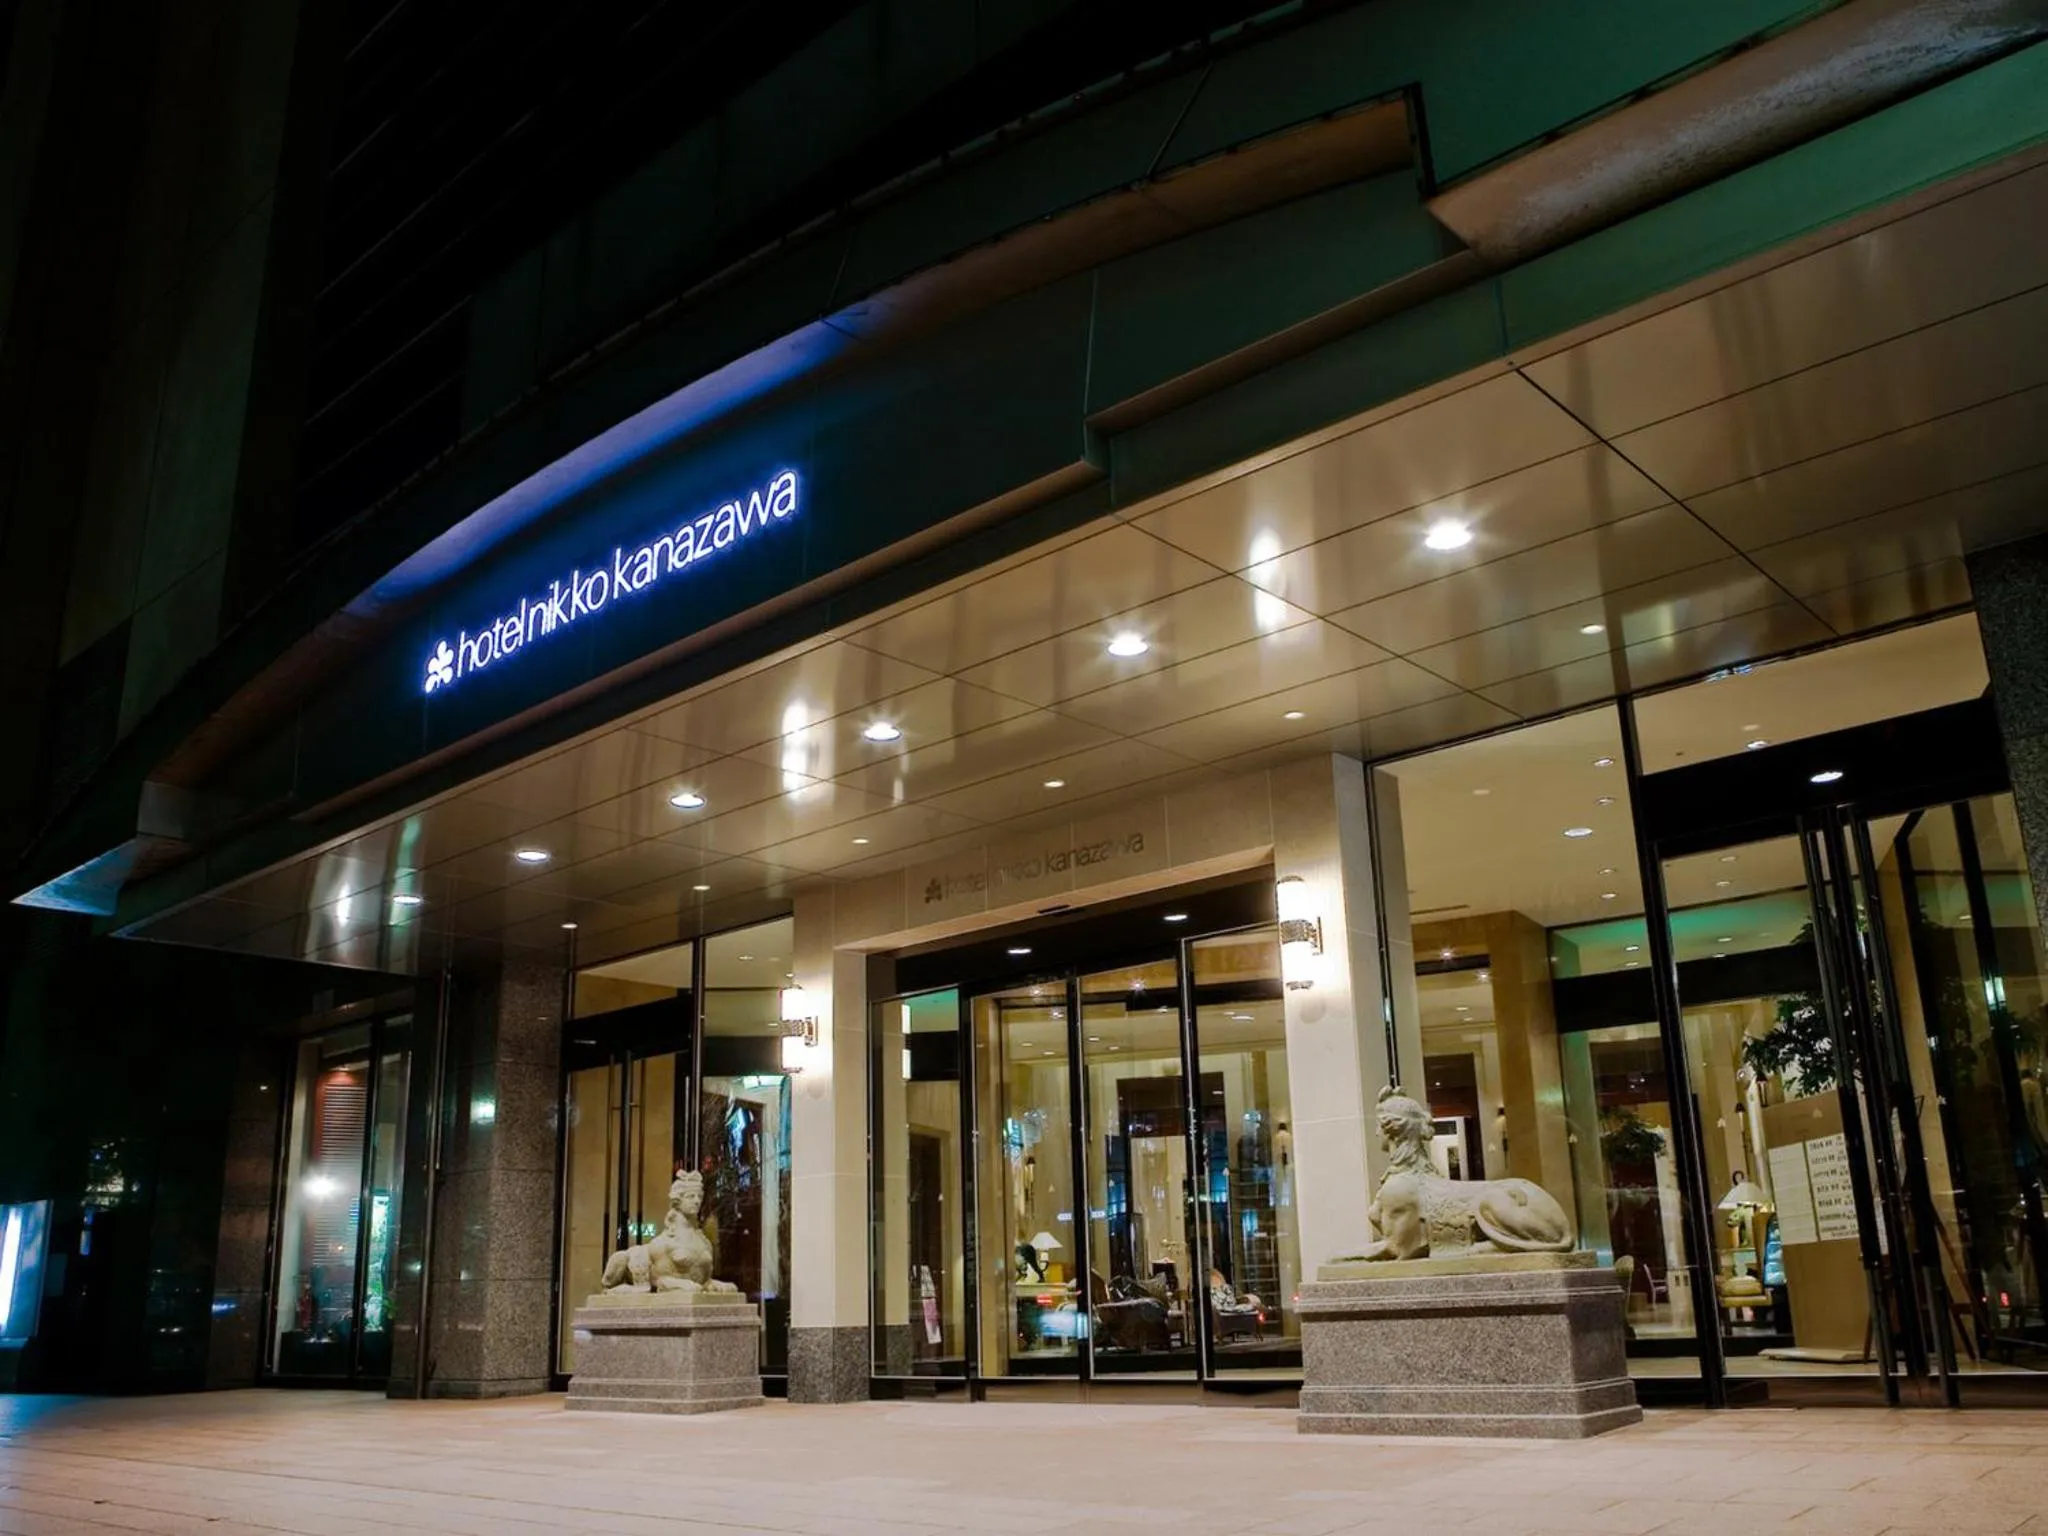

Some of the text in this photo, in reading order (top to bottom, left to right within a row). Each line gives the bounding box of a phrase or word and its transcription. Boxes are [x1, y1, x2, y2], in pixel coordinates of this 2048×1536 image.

[456, 471, 797, 678] hotel nikko kanazawa
